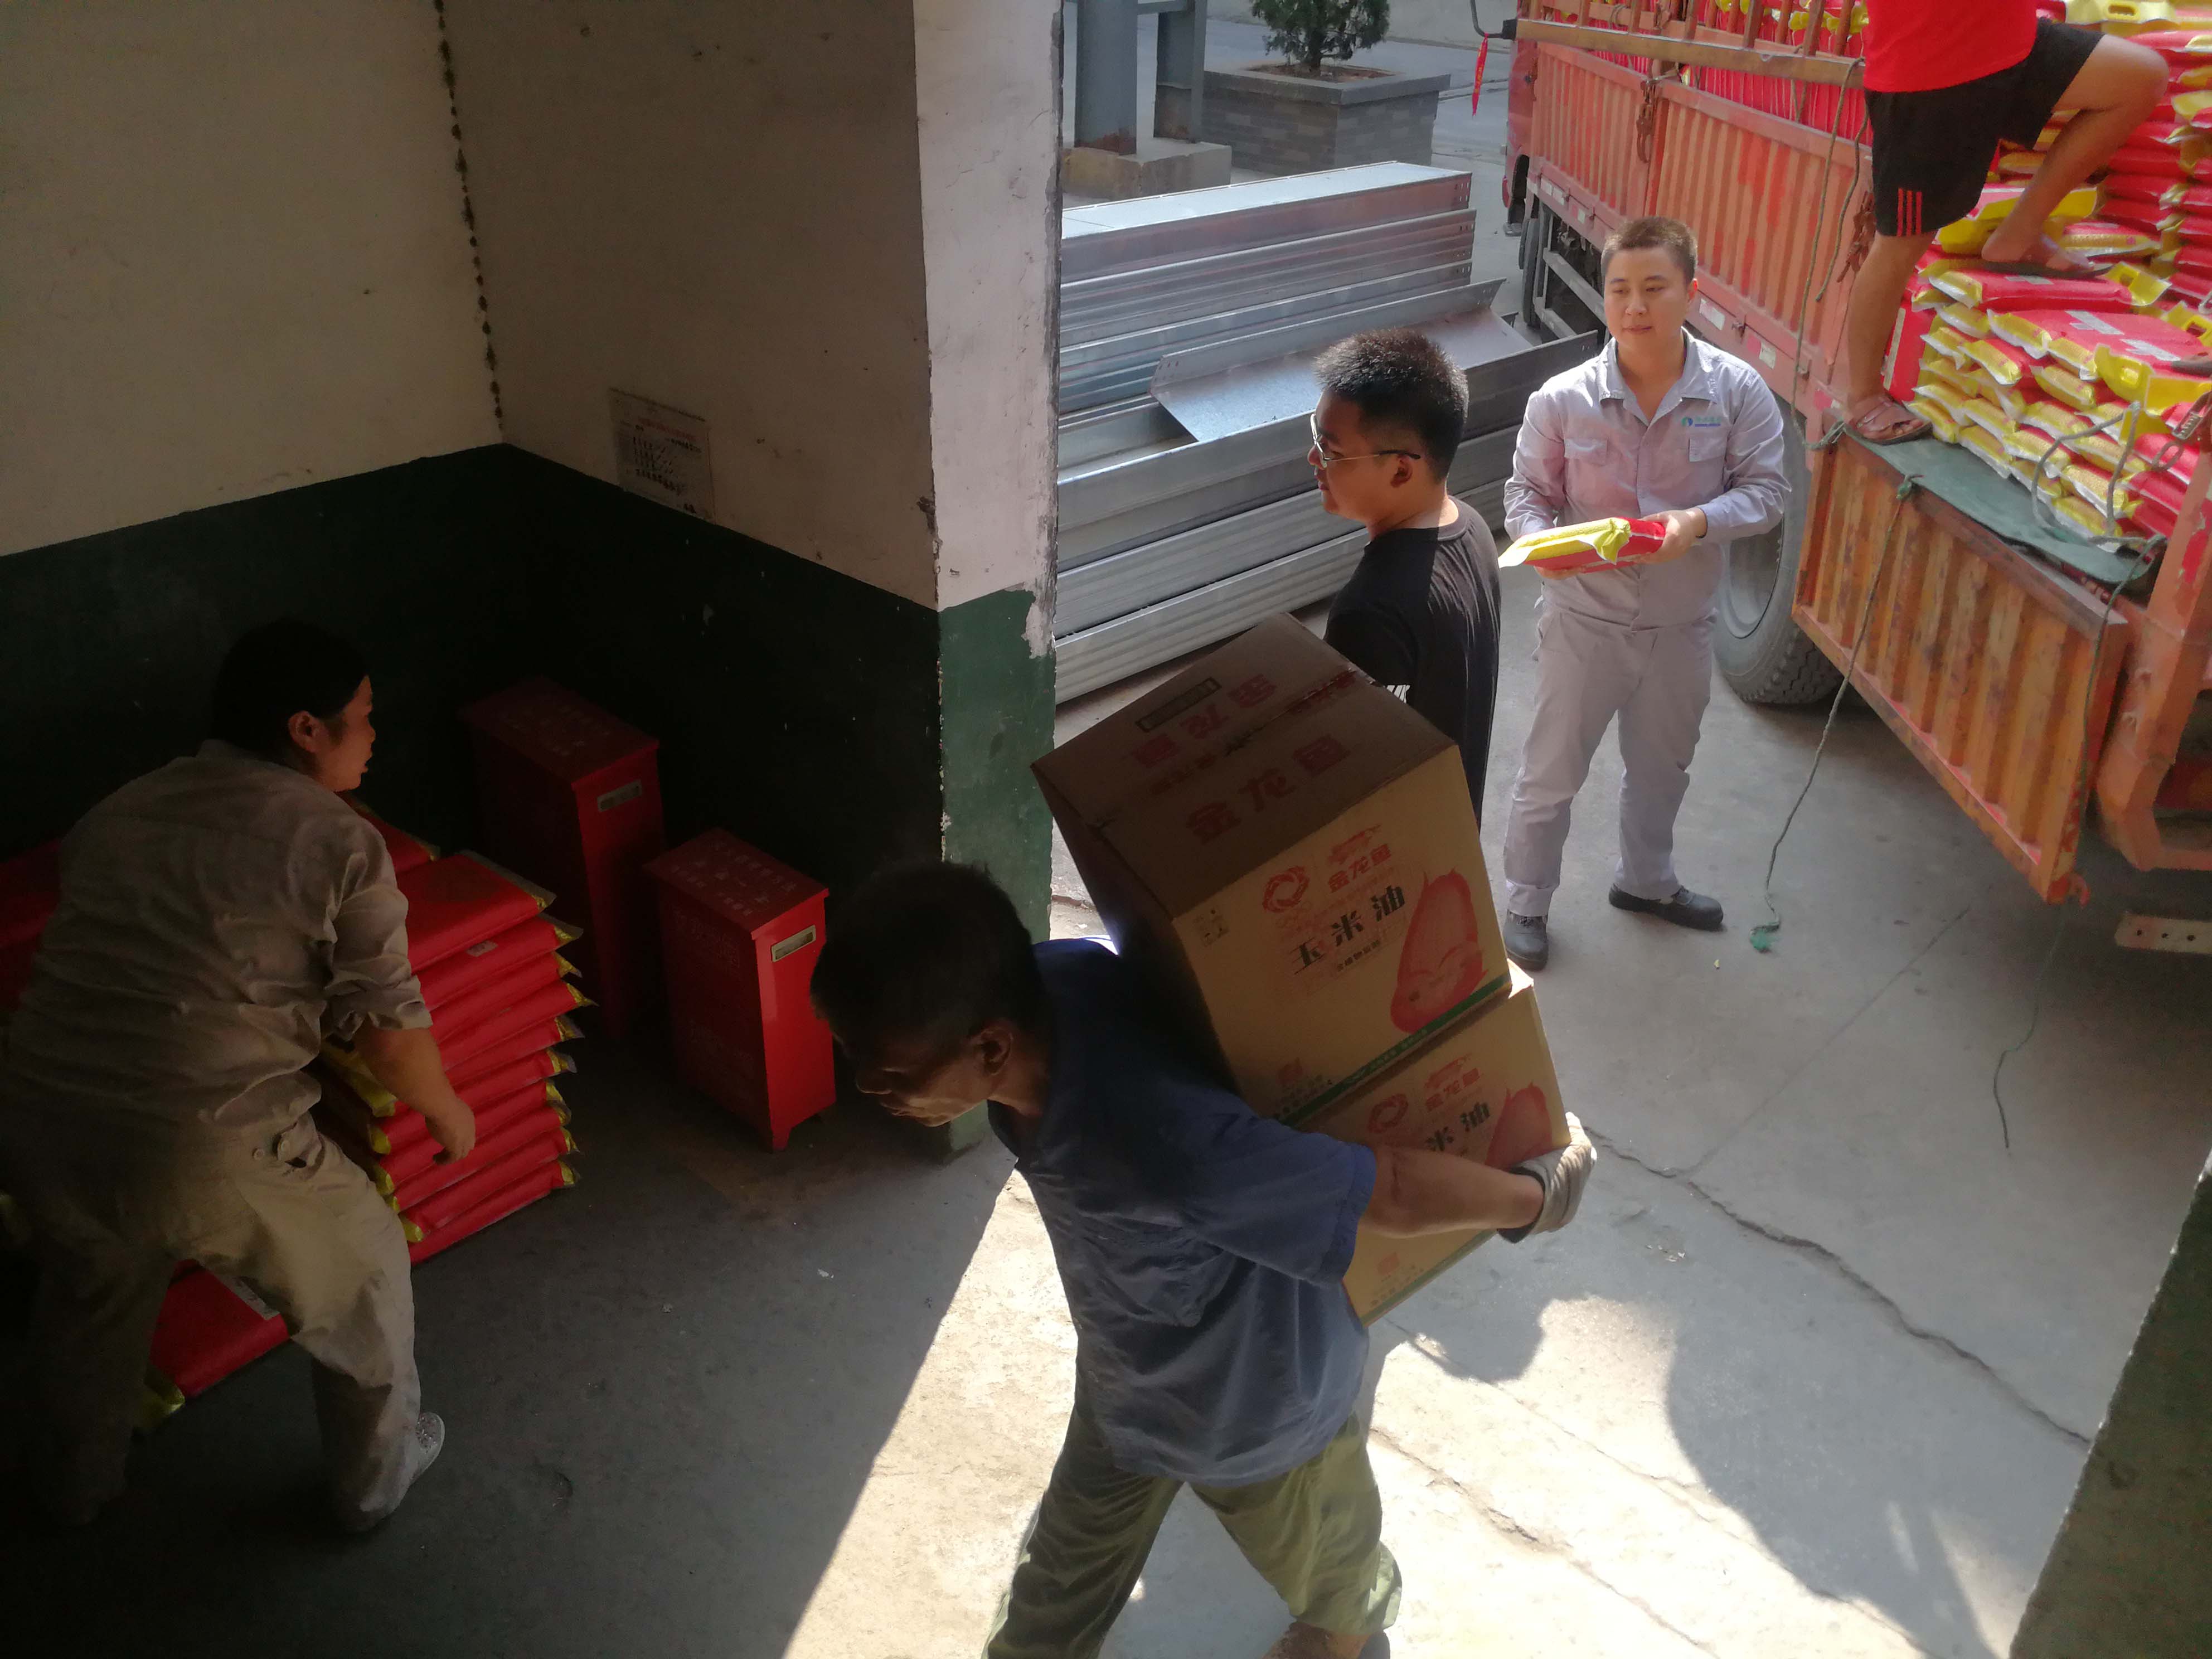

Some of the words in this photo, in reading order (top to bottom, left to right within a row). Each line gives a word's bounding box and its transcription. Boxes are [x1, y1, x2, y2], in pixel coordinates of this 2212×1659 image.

[1186, 734, 1351, 845] 金龙鱼
[1328, 843, 1392, 893] 金龙鱼
[1288, 885, 1405, 975] 玉米油
